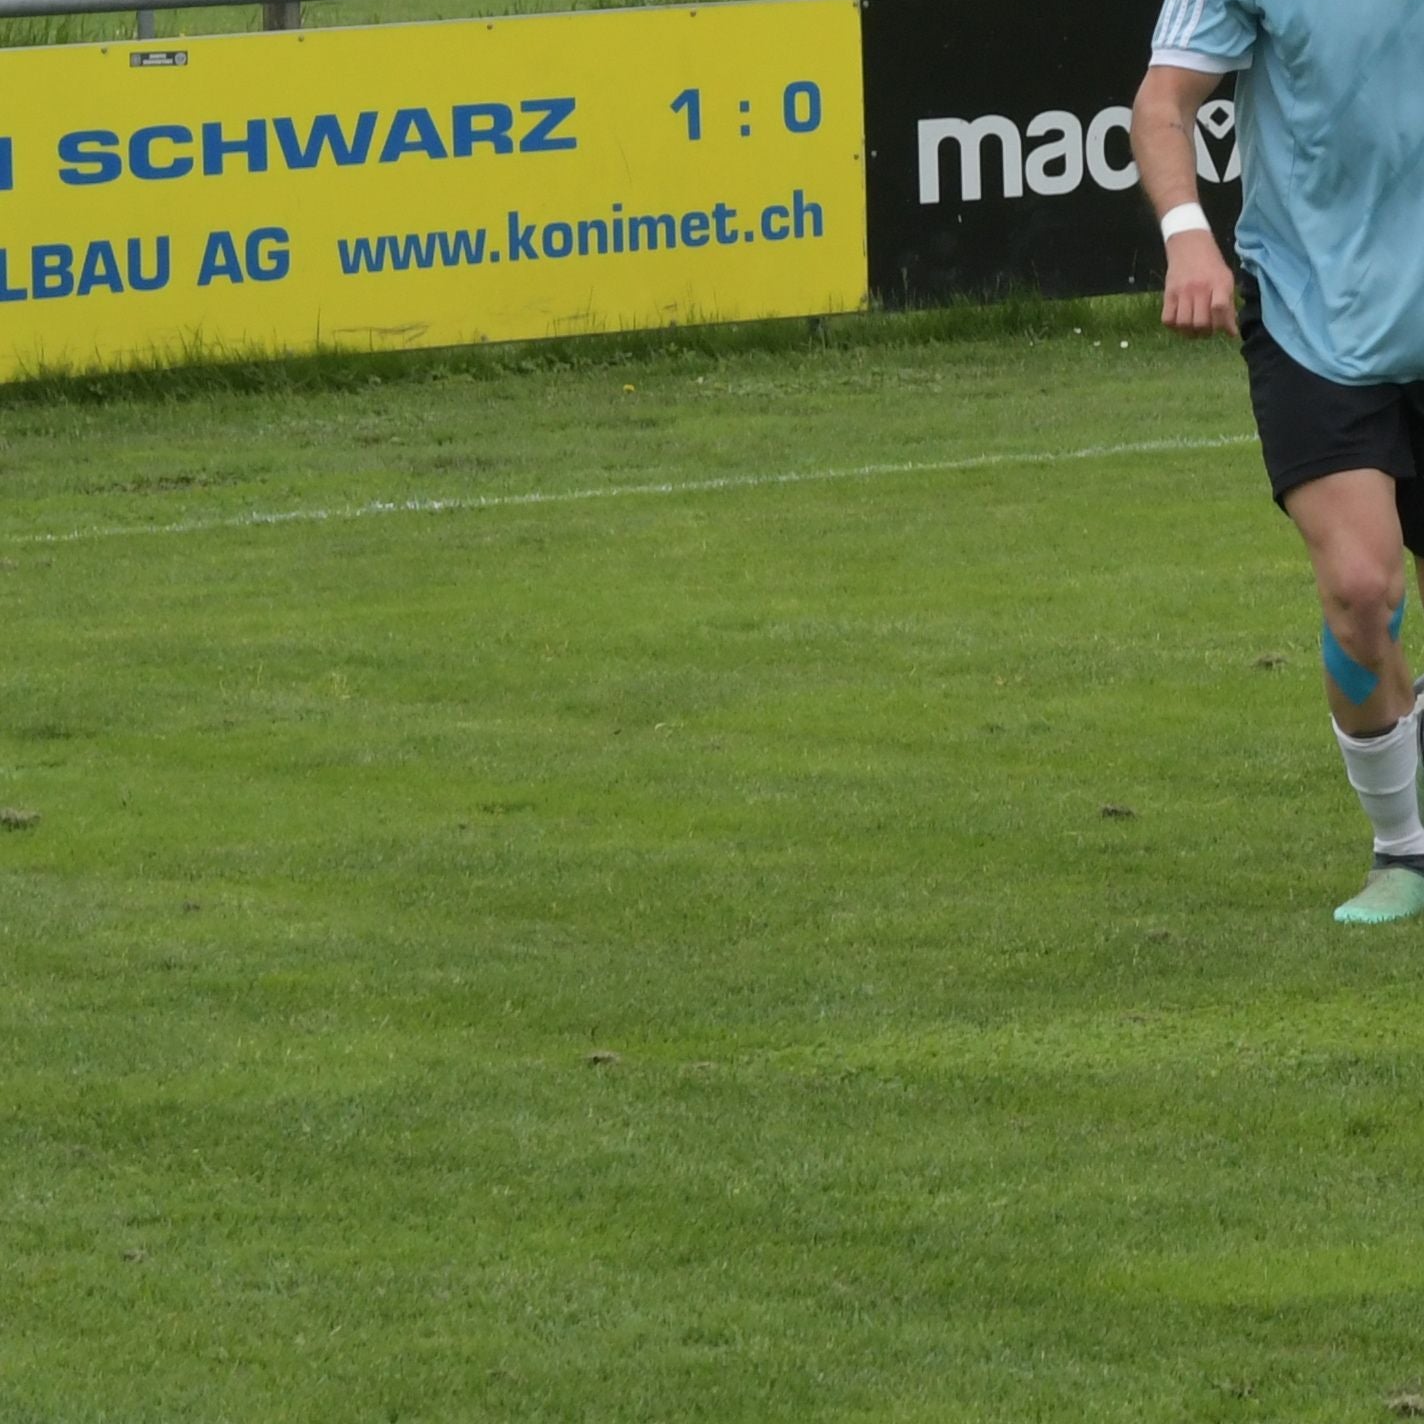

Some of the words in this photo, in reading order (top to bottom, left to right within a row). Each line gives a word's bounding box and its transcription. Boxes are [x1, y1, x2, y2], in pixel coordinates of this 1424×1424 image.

[57, 96, 578, 186] SCHWARZ
[196, 226, 291, 287] AG
[337, 189, 824, 276] www.konimet.ch
